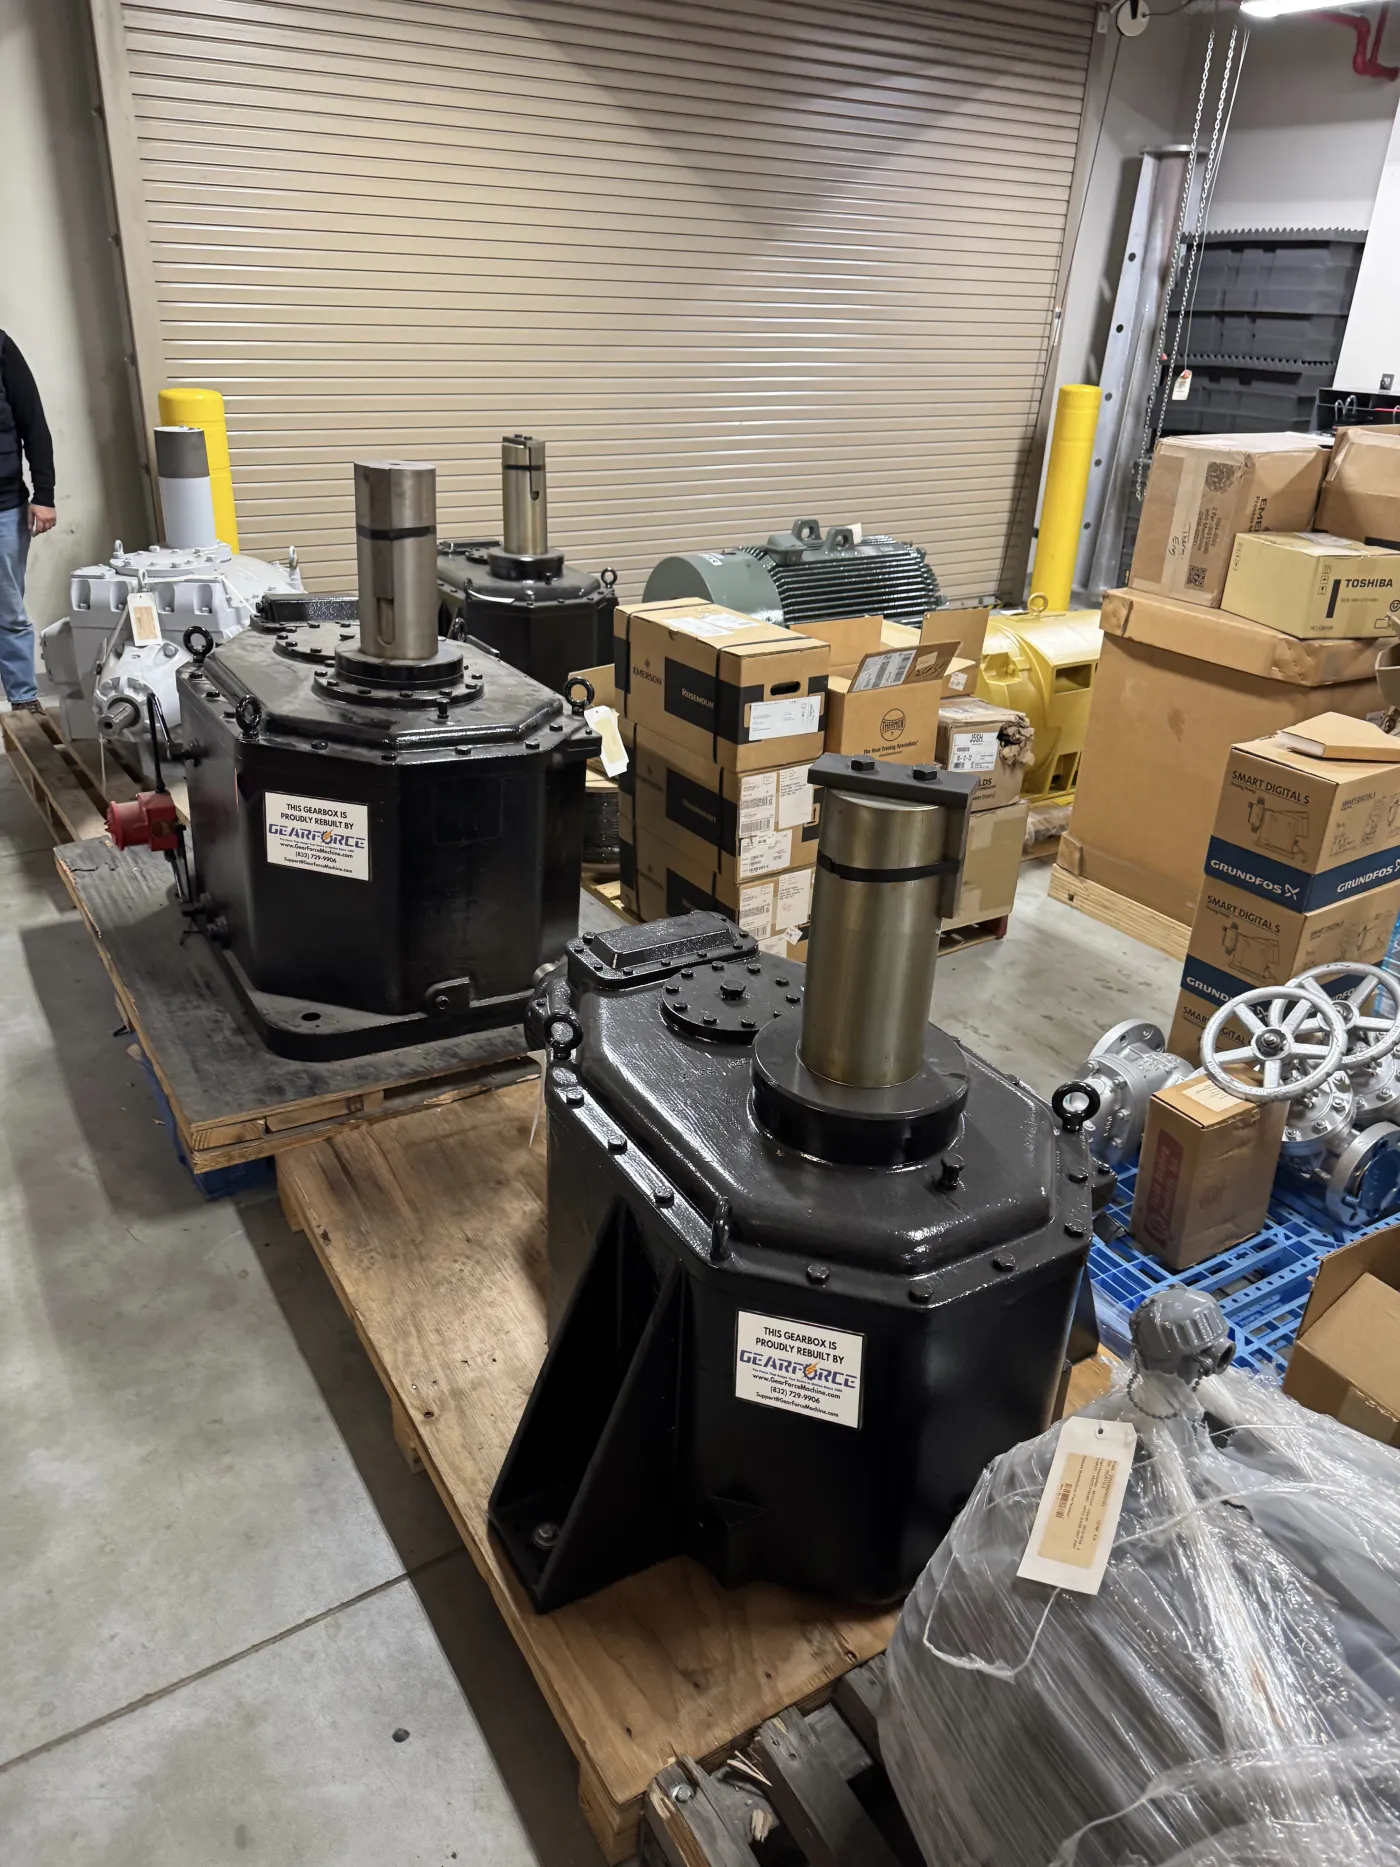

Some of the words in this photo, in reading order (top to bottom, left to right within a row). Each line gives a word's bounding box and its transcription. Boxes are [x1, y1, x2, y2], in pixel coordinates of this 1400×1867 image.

[1254, 498, 1267, 533] EME
[1344, 578, 1393, 588] TOSHIBA
[633, 666, 662, 686] EMERSON
[682, 688, 715, 710] ROSEMOUN
[882, 718, 904, 732] THERMON
[882, 744, 896, 752] Tracing
[1232, 770, 1264, 788] SMART
[1265, 782, 1301, 802] DIGITAL
[1303, 795, 1310, 804] S
[280, 813, 313, 824] PROUDLY
[314, 818, 342, 828] REBUILT
[344, 822, 354, 830] BY
[286, 804, 302, 812] THIS
[303, 806, 338, 818] GEARBOX
[268, 823, 366, 849] GEARFORCE
[280, 842, 353, 858] www.GearForceMachine.com
[295, 851, 310, 860] (832)
[310, 853, 337, 864] 729-9906
[1210, 860, 1282, 894] GRUNDFOS
[1336, 865, 1393, 893] GRUNDFOS
[1208, 895, 1237, 913] SMART
[1239, 909, 1273, 931] DIGITAL
[1275, 925, 1281, 933] S
[1186, 976, 1232, 1002] GRUND
[756, 1337, 795, 1353] PROUDLY
[796, 1347, 830, 1362] REBUILT
[833, 1355, 844, 1364] BY
[764, 1327, 782, 1338] THIS
[784, 1331, 827, 1349] GEARBOX
[828, 1341, 837, 1350] IS
[740, 1350, 857, 1388] GEARFORCE
[752, 1374, 841, 1399] www.GearForceMachine.com
[770, 1386, 788, 1397] (832)
[788, 1390, 820, 1403] 729-9906
[756, 1392, 839, 1417] Support@GearForceMachine.com
